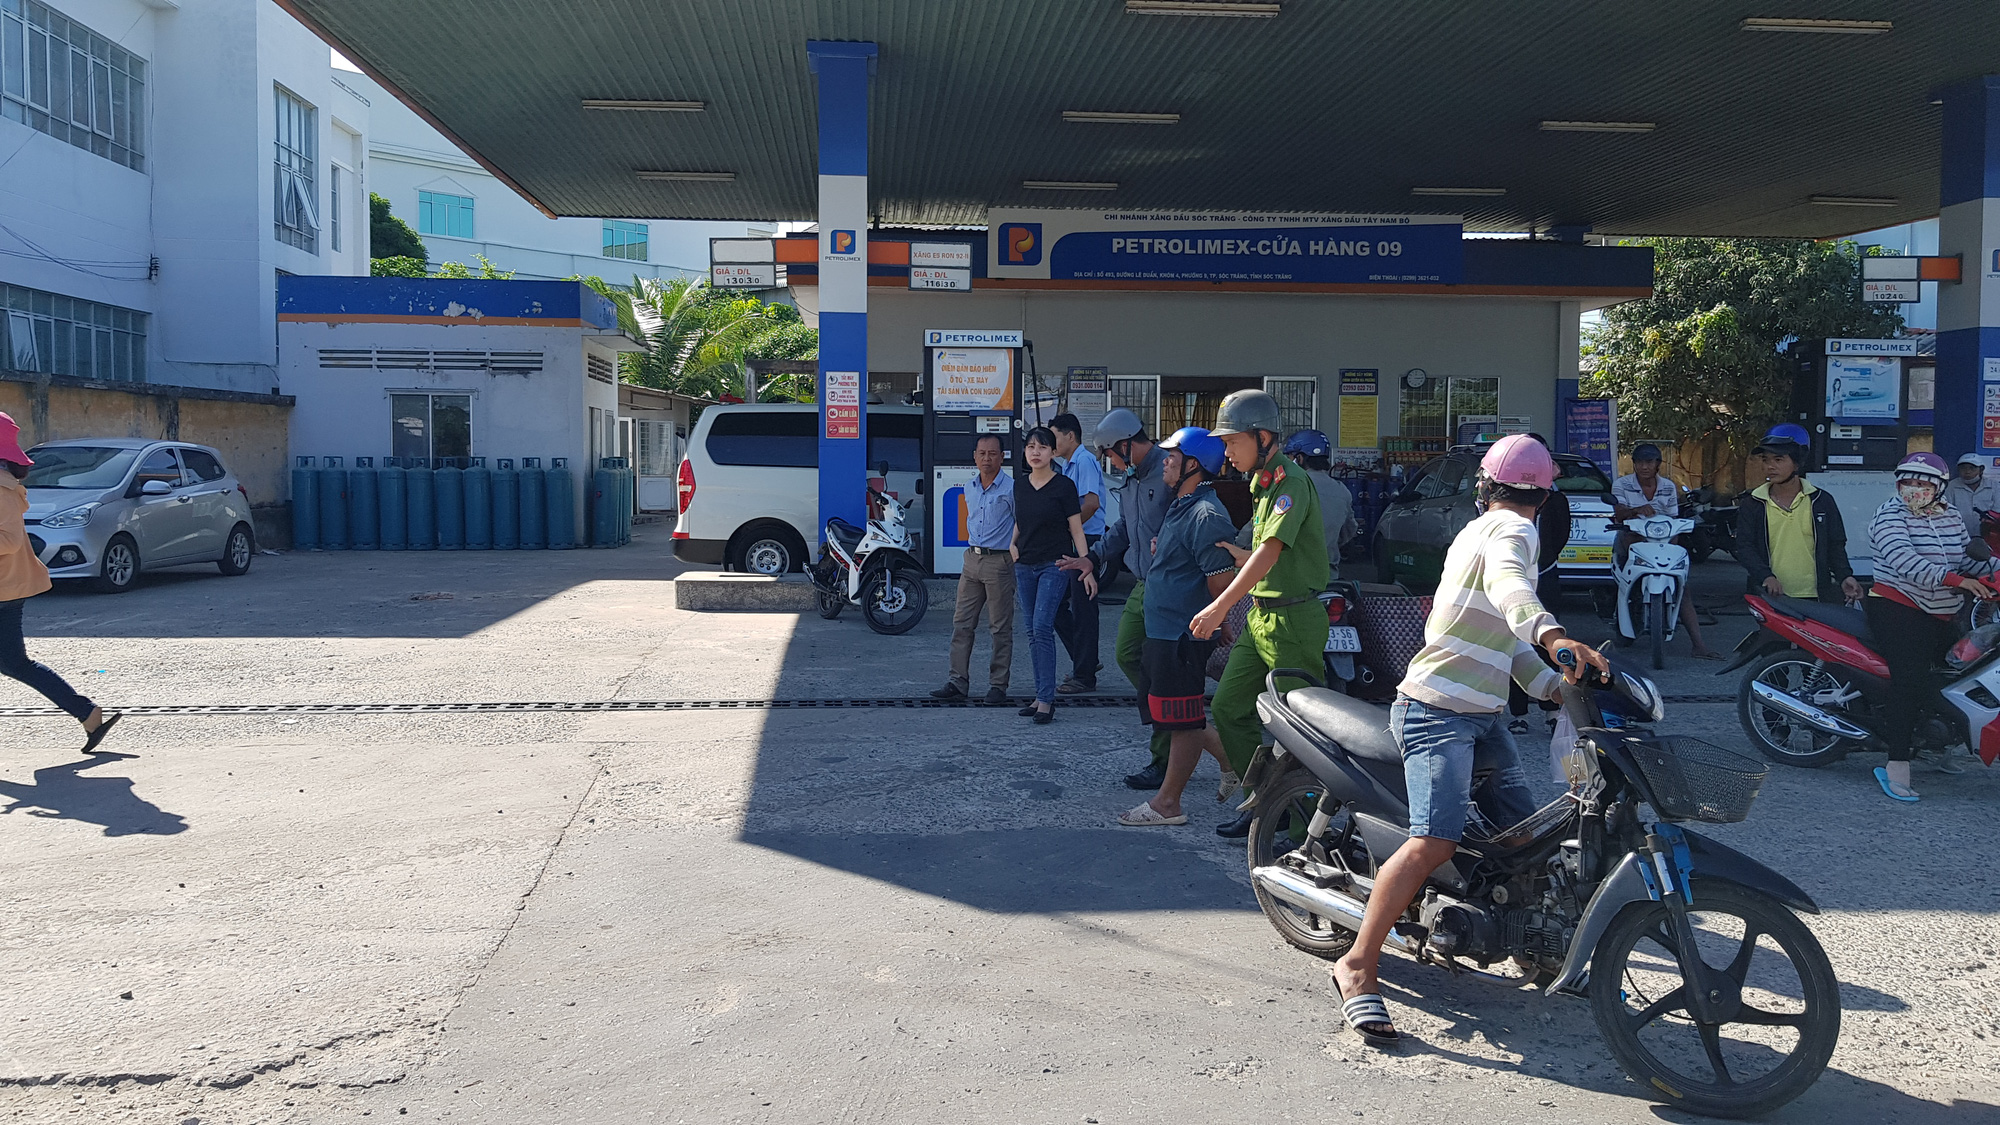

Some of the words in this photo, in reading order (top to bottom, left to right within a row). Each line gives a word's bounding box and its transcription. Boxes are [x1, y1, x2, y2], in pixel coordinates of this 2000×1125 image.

[1104, 213, 1118, 221] CHI
[1120, 212, 1148, 222] NHÁNH
[1149, 212, 1171, 222] XĂNG
[1173, 212, 1190, 222] DẦU
[1191, 213, 1208, 223] SÓC
[1209, 213, 1236, 223] TRĂNG
[1242, 213, 1264, 223] CÔNG
[1266, 215, 1277, 223] TY
[1279, 215, 1300, 223] TNHH
[1302, 215, 1319, 223] MTV
[1321, 214, 1343, 224] XĂNG
[1345, 214, 1361, 224] DẦU
[1362, 215, 1377, 224] TÂY
[1379, 216, 1397, 224] NAM
[1309, 236, 1371, 257] HÀNG
[1376, 241, 1403, 258] 09
[913, 250, 931, 259] XĂNG
[715, 266, 730, 275] GIÁ
[913, 269, 928, 278] GIÁ
[945, 334, 1018, 343] PETROLIMEX
[1844, 343, 1912, 352] PETROLIMEX
[967, 376, 975, 384] XE
[970, 387, 982, 395] CON
[1569, 529, 1586, 540] 0.72
[1329, 628, 1352, 639] 3-S6
[1327, 639, 1355, 650] 2785
[1161, 699, 1204, 720] PUM
